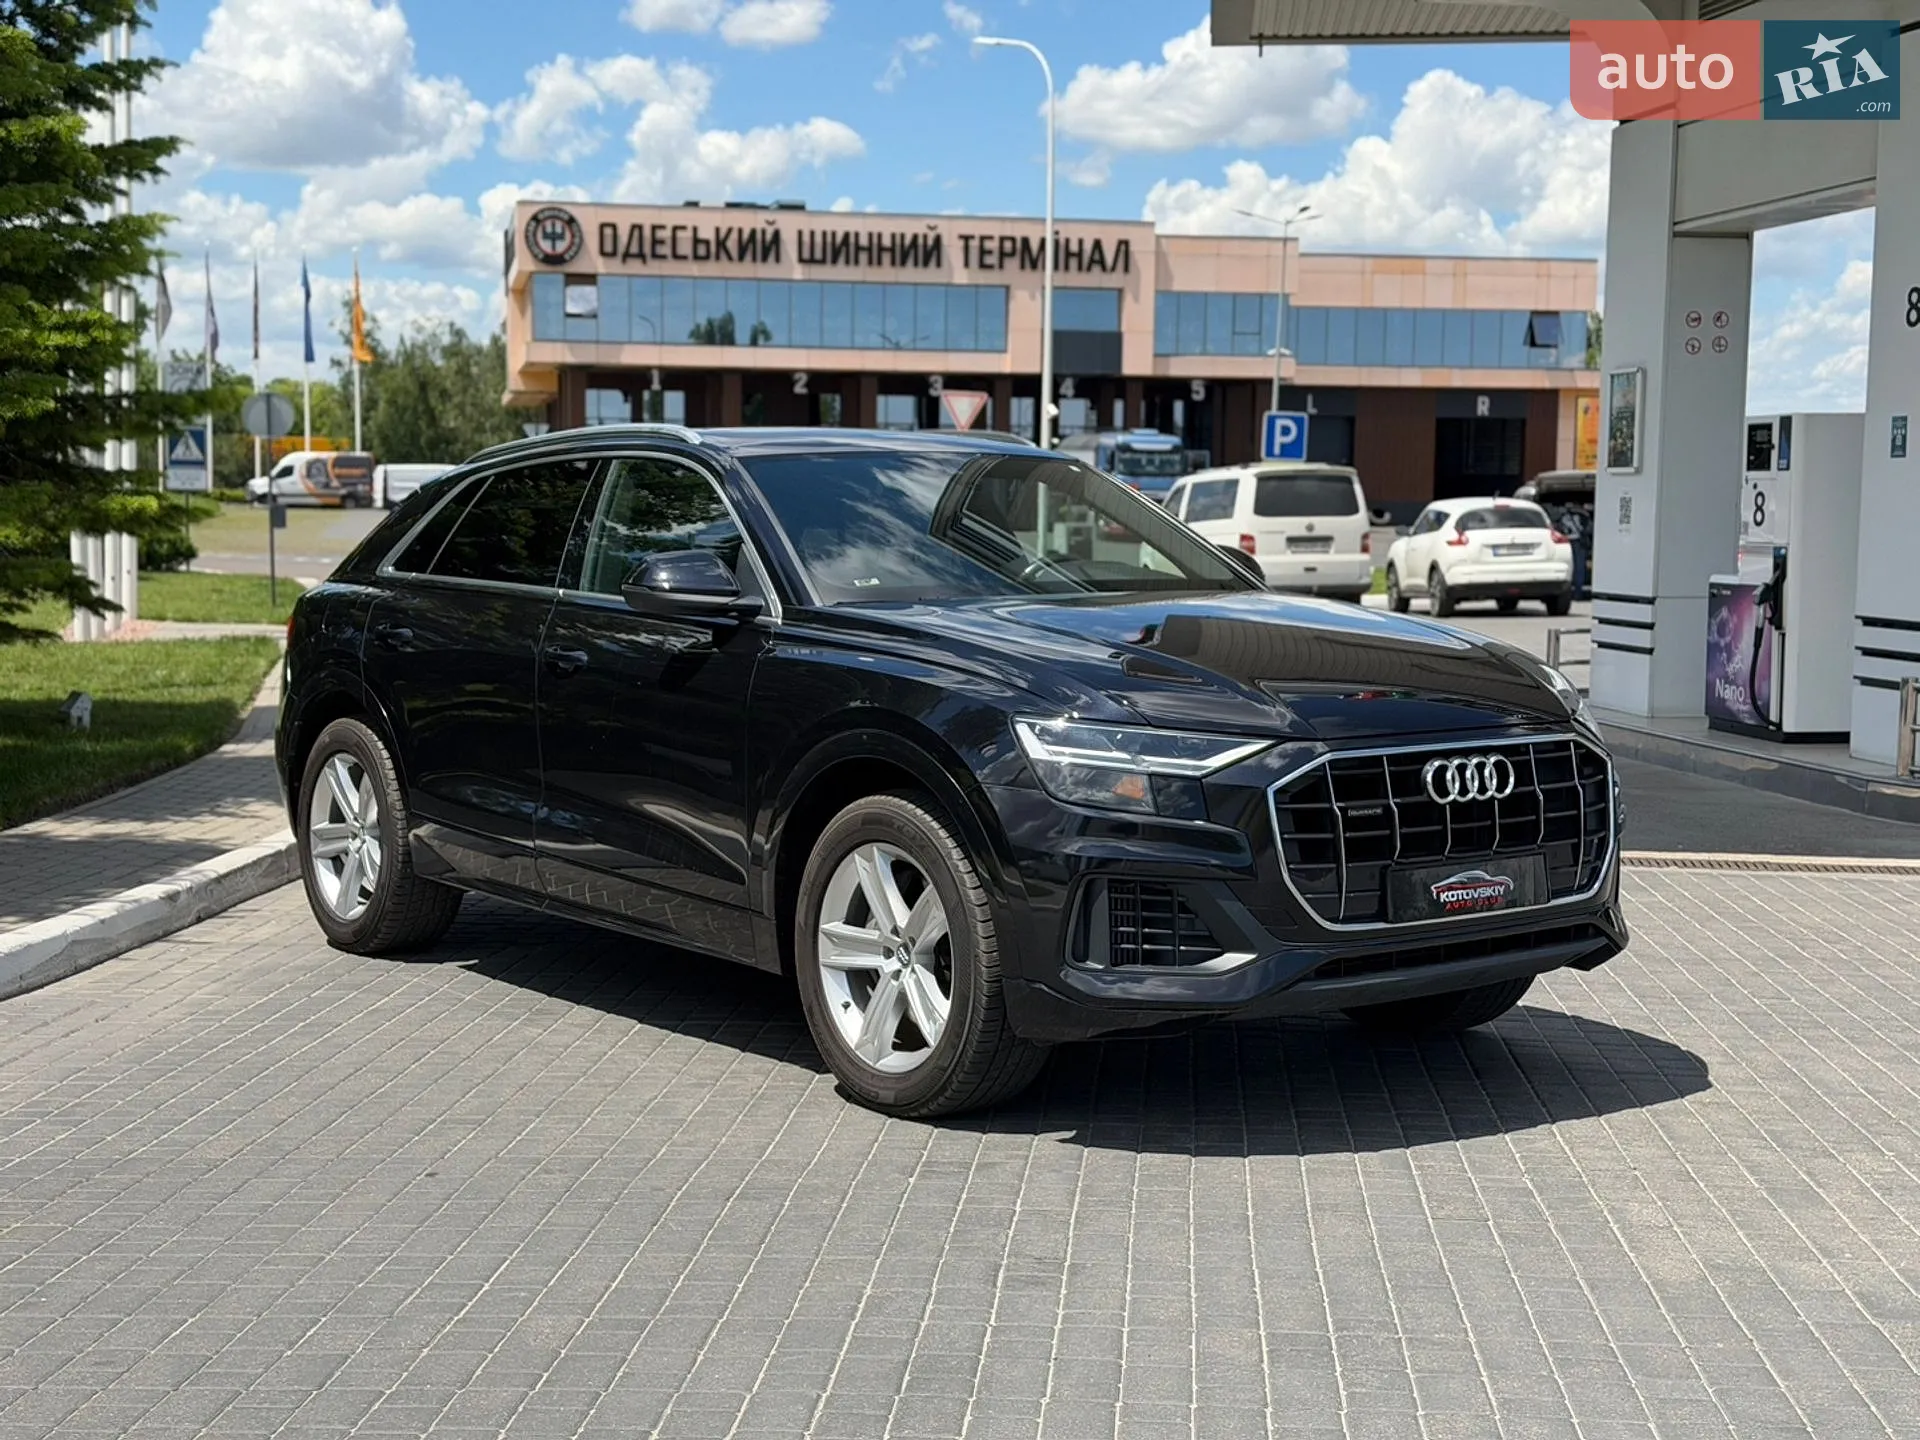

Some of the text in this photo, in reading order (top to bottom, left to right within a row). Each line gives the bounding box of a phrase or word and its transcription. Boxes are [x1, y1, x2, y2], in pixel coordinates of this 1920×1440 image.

[599, 219, 781, 265] ОДЕСЬКИЙ
[797, 224, 941, 268] ШИННИЙ
[958, 230, 1130, 273] ТЕРМІНАЛ
[651, 368, 662, 390] 1
[793, 372, 809, 395] 2
[928, 375, 943, 397] 3
[1059, 377, 1076, 398] 4
[1191, 379, 1206, 401] 5
[1306, 393, 1318, 415] L
[1476, 395, 1490, 417] R
[1274, 418, 1298, 456] P
[1753, 491, 1765, 527] 8
[1715, 678, 1744, 701] Nano
[1440, 885, 1505, 903] KOTOVSKIY
[1444, 901, 1473, 912] AUTO
